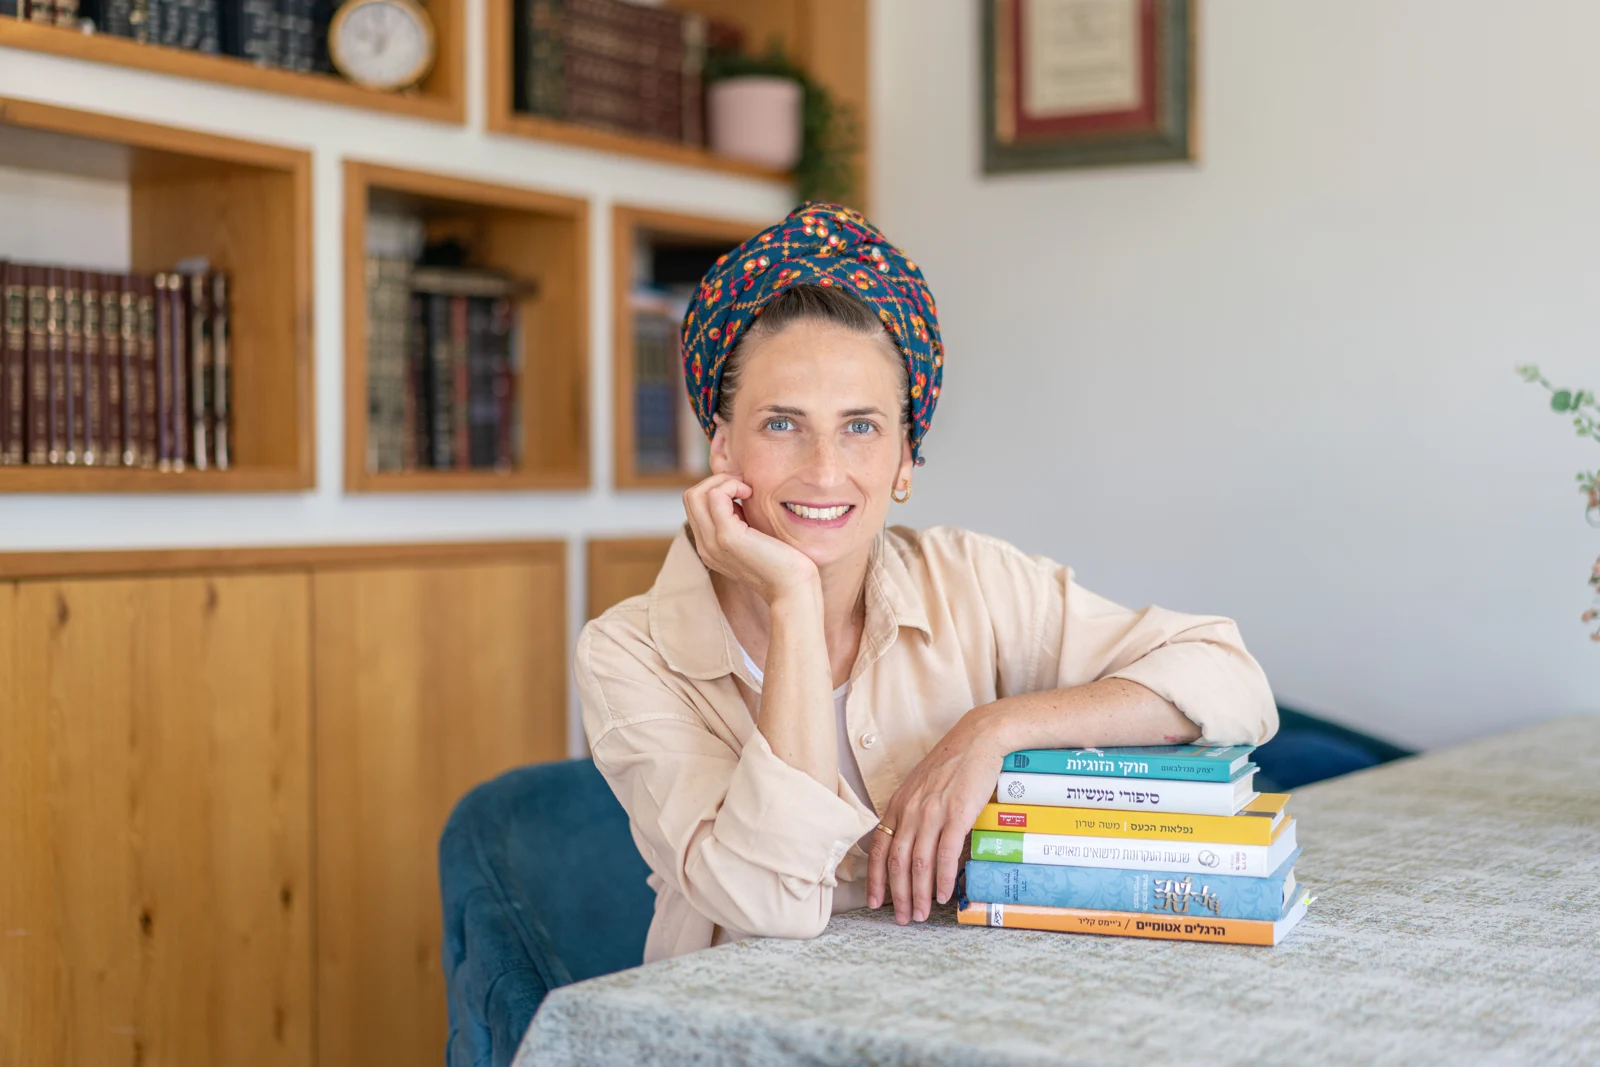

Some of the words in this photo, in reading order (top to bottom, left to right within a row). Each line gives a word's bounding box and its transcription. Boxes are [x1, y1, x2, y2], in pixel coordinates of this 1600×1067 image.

[1066, 758, 1115, 772] הזוגיות
[1118, 760, 1149, 776] חוקי
[1196, 767, 1214, 775] יצחק
[1066, 787, 1115, 802] מעשיות
[1119, 790, 1160, 804] סיפורי
[1075, 819, 1095, 830] שרון
[1098, 820, 1121, 830] משה
[1130, 822, 1157, 832] הכעס
[1159, 823, 1194, 834] נפלאות
[1043, 844, 1080, 857] מאושרים
[1083, 846, 1121, 860] לנישואים
[1122, 848, 1162, 863] העקרונות
[1164, 850, 1190, 864] שבעת
[1078, 916, 1096, 927] קליר
[1136, 920, 1182, 933] אטומיים
[1184, 923, 1226, 936] הרגלים
